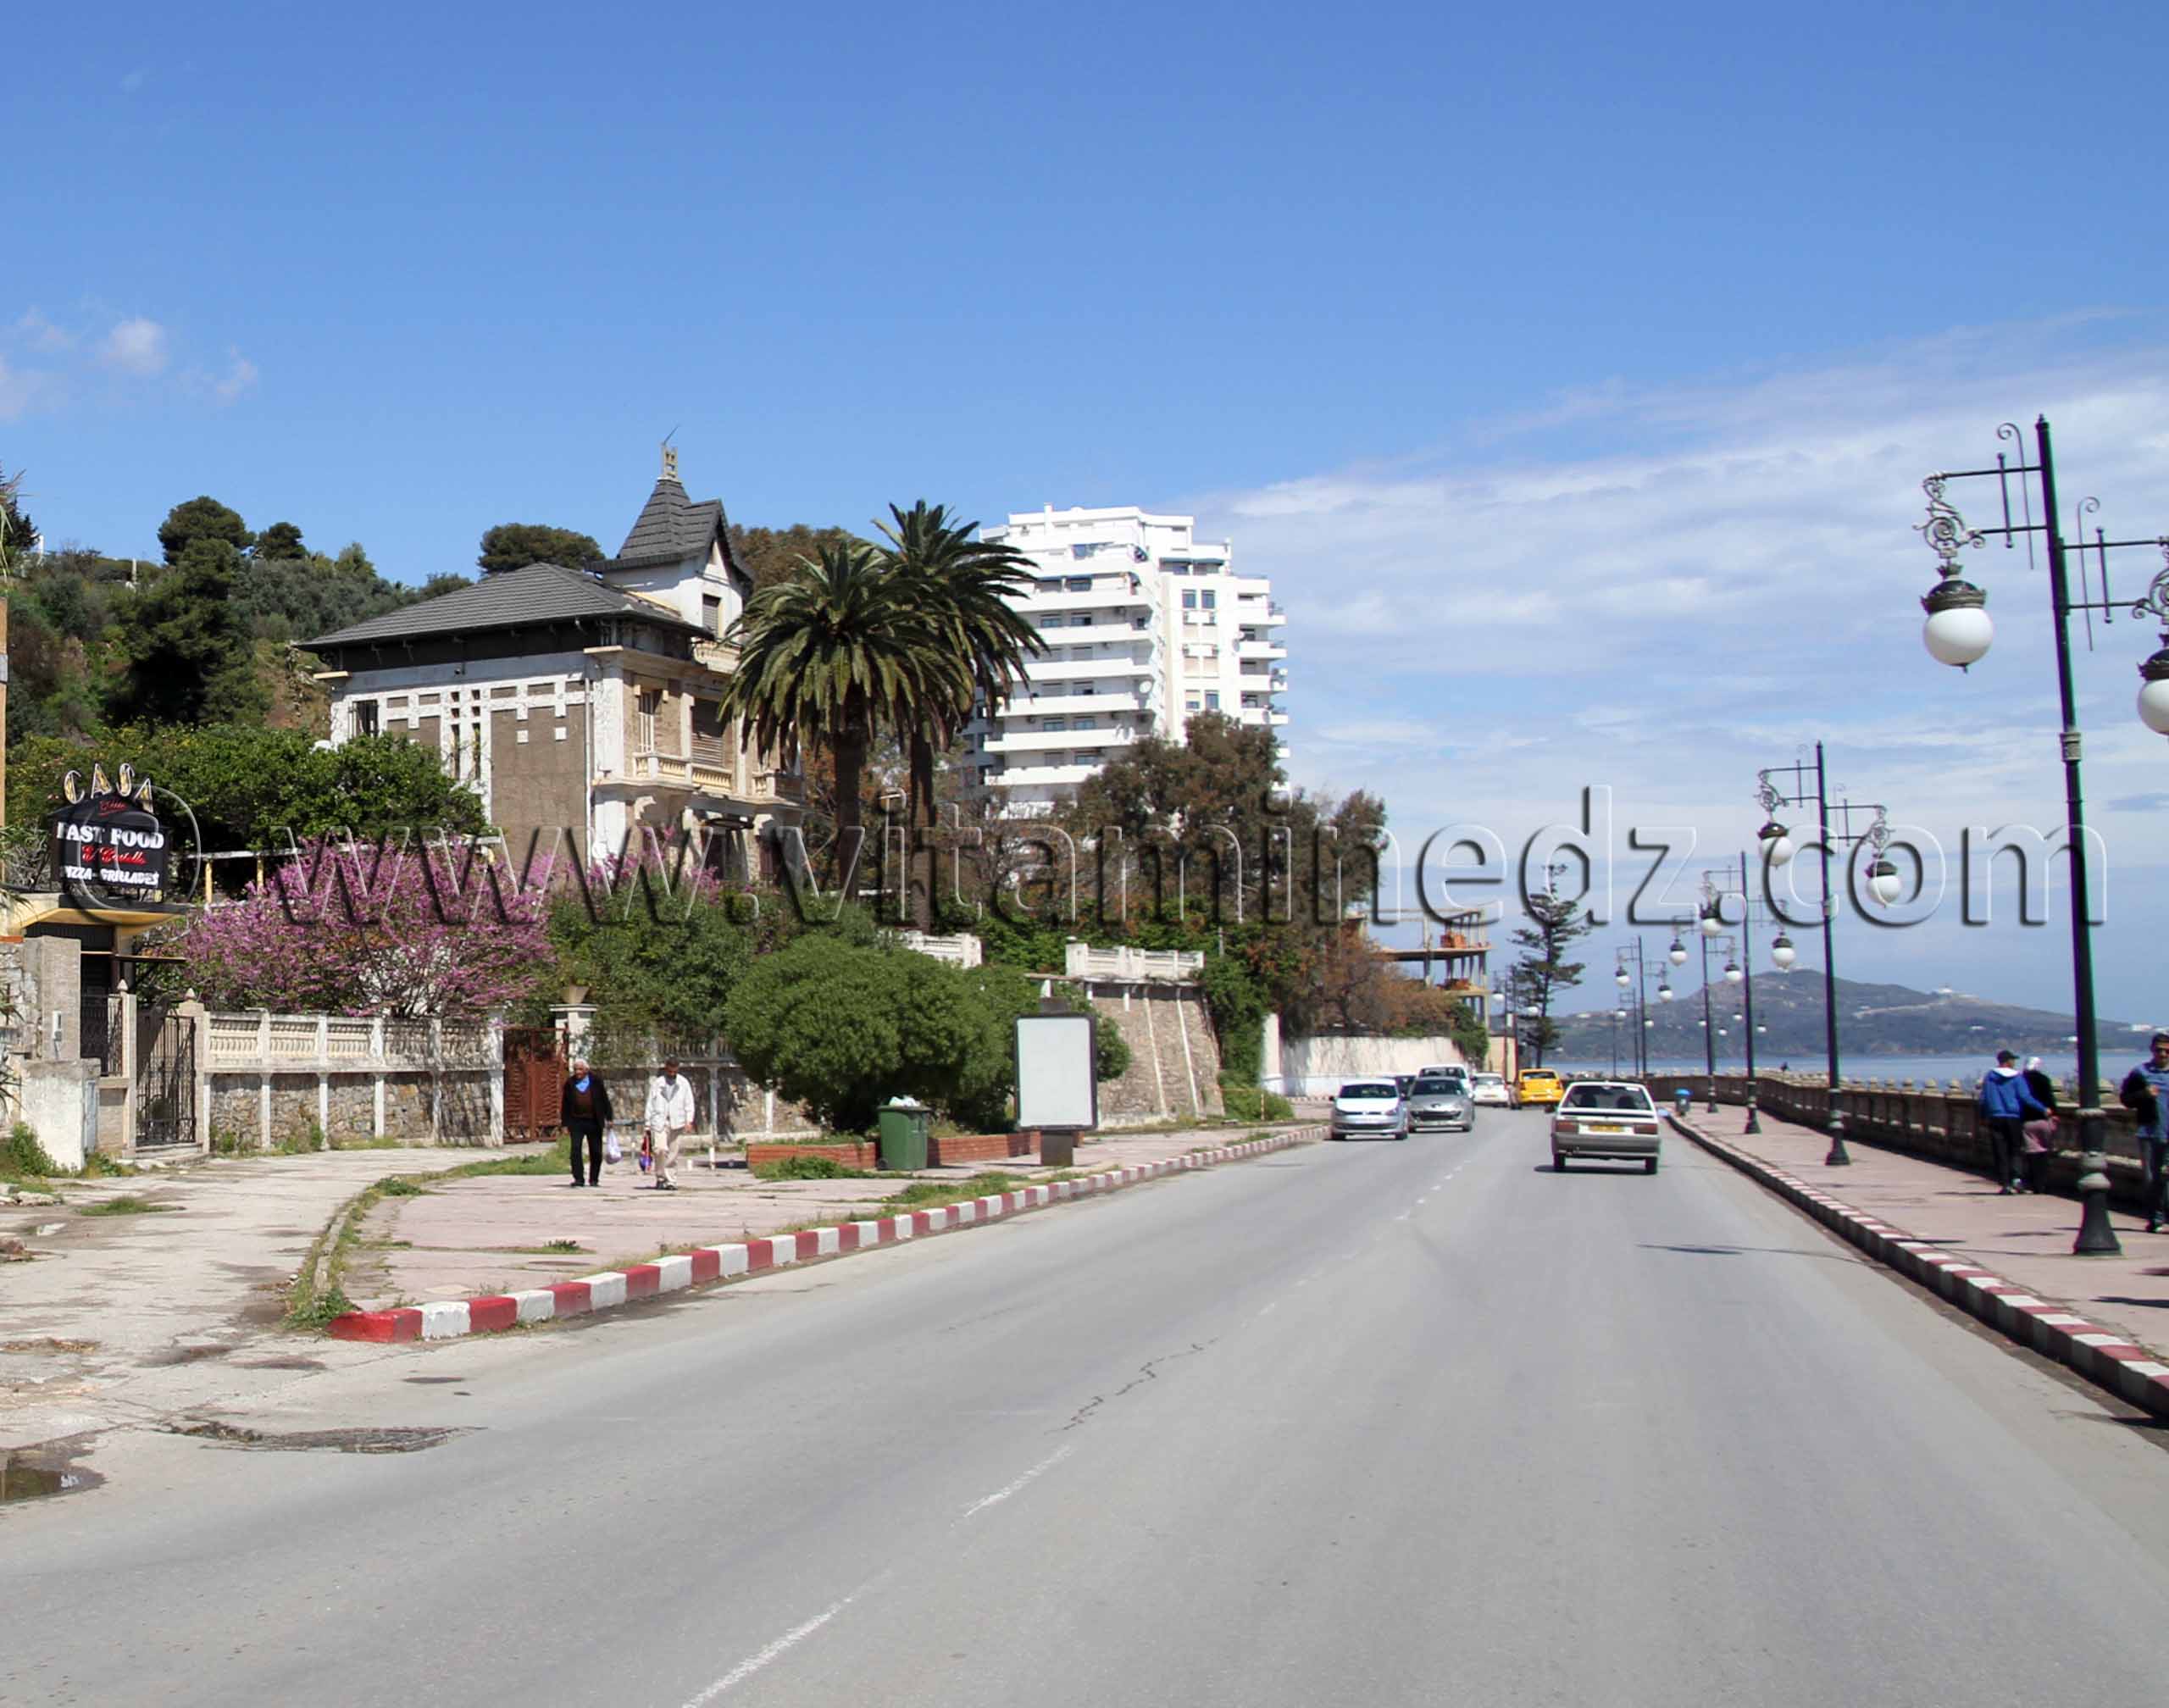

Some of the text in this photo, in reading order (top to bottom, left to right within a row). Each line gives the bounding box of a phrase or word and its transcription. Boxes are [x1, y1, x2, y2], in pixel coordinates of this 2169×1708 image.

[63, 762, 154, 813] CASA
[56, 821, 164, 849] FAST FOOD
